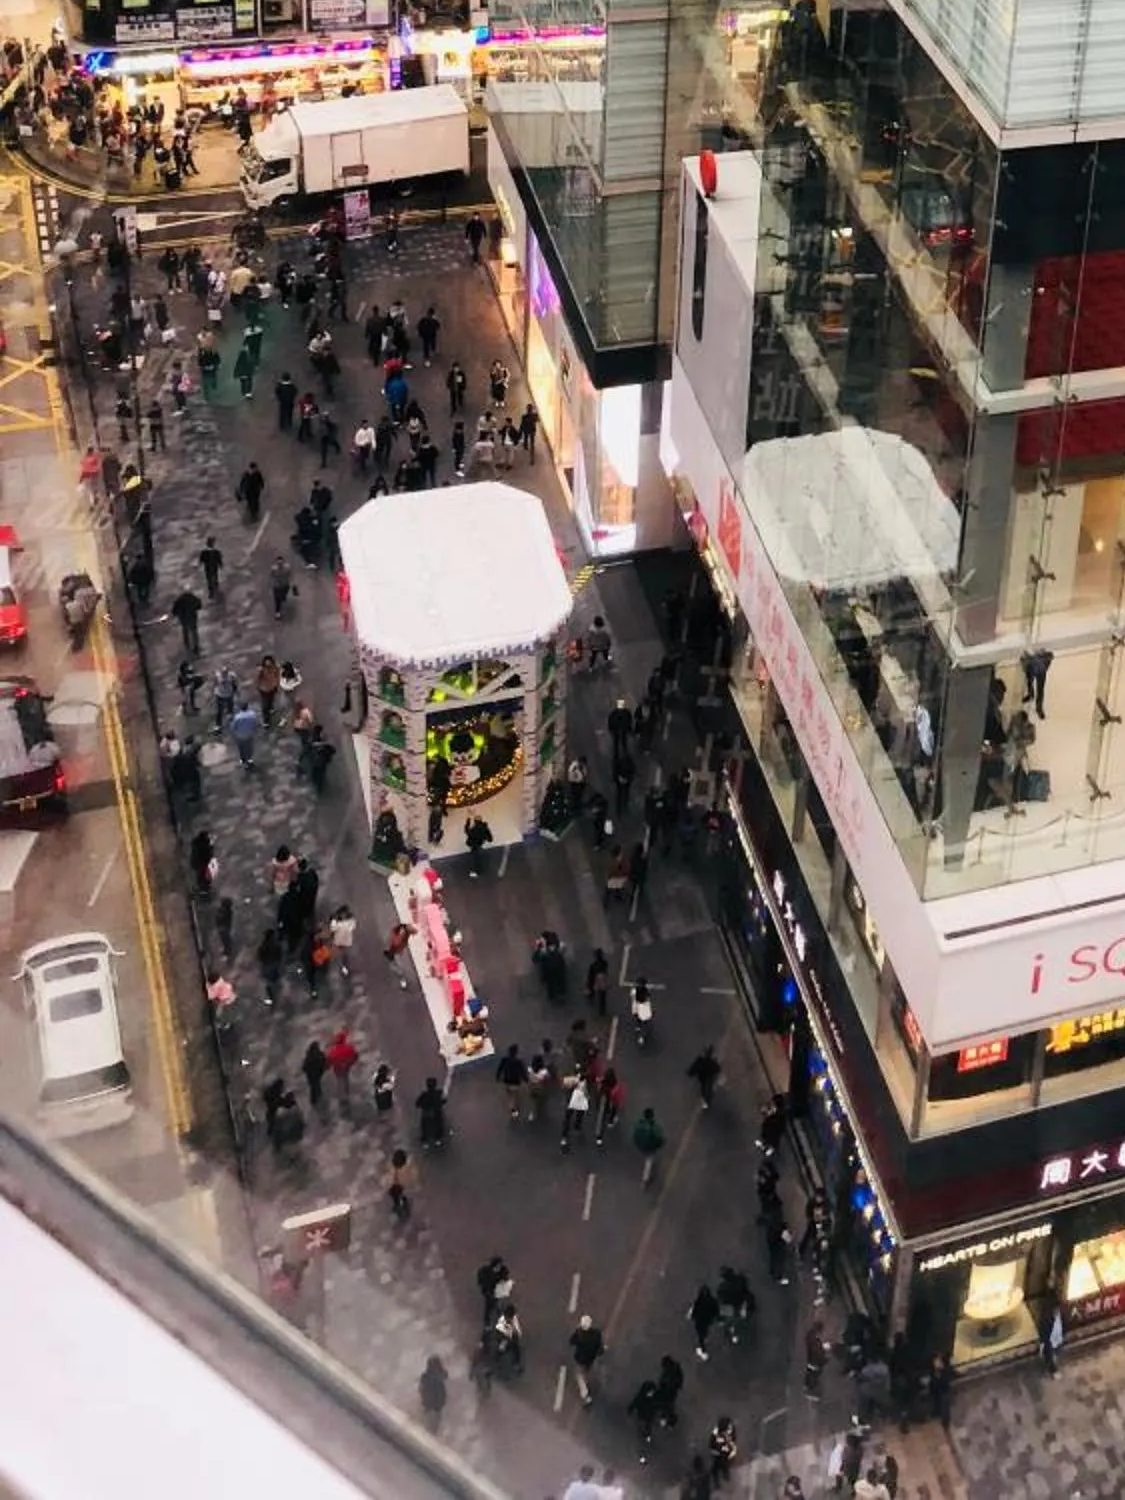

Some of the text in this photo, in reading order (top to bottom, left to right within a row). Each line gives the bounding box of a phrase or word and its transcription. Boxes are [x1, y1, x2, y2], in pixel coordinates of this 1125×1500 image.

[919, 1222, 1054, 1273] HEARTS ON FIRE
